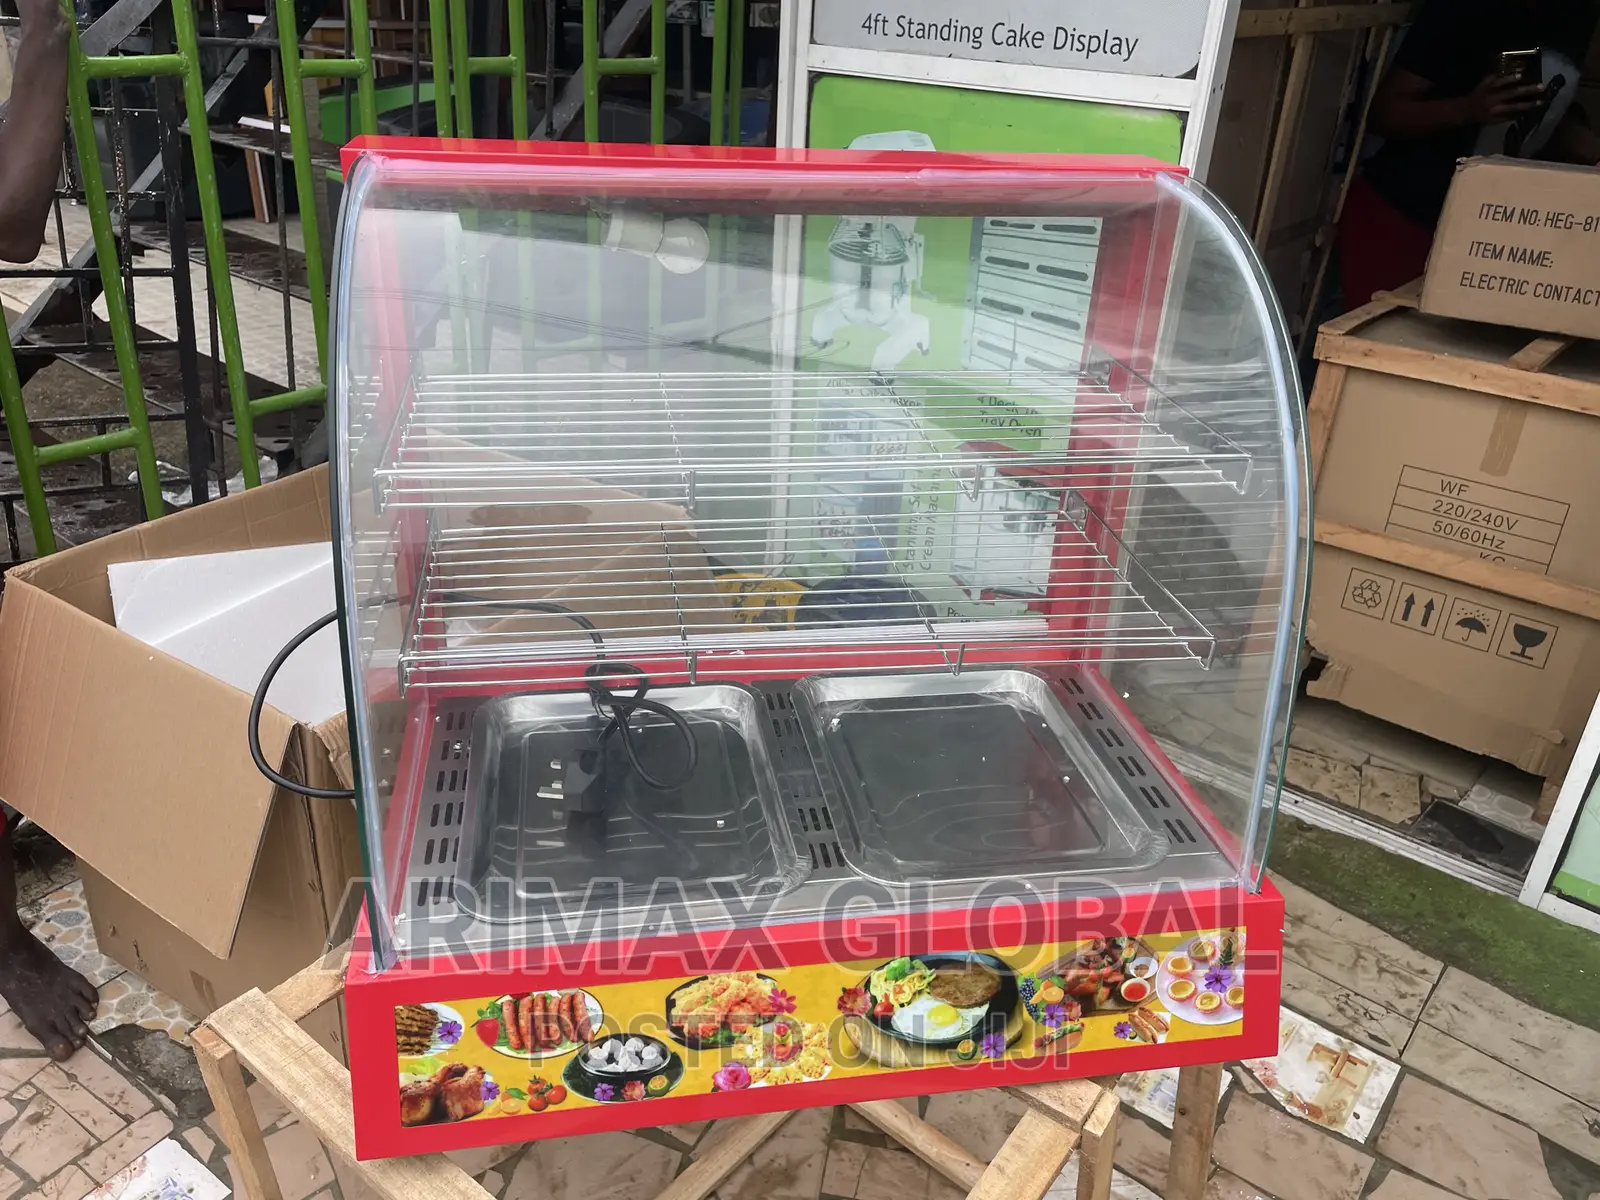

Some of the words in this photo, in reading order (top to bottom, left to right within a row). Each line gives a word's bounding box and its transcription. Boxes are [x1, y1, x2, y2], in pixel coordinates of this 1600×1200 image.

[861, 13, 889, 37] 4ft
[895, 14, 984, 50] Standing
[991, 22, 1045, 49] Cake
[1053, 26, 1139, 62] Display
[1478, 203, 1516, 223] ITEM
[1517, 208, 1541, 227] NO:
[1468, 241, 1505, 261] ITEM
[1506, 246, 1554, 268] NAME:
[1460, 271, 1530, 296] ELECTRIC
[1440, 479, 1470, 496] WF
[1432, 499, 1519, 531] 220/240V
[1432, 520, 1506, 550] 50/60Hz
